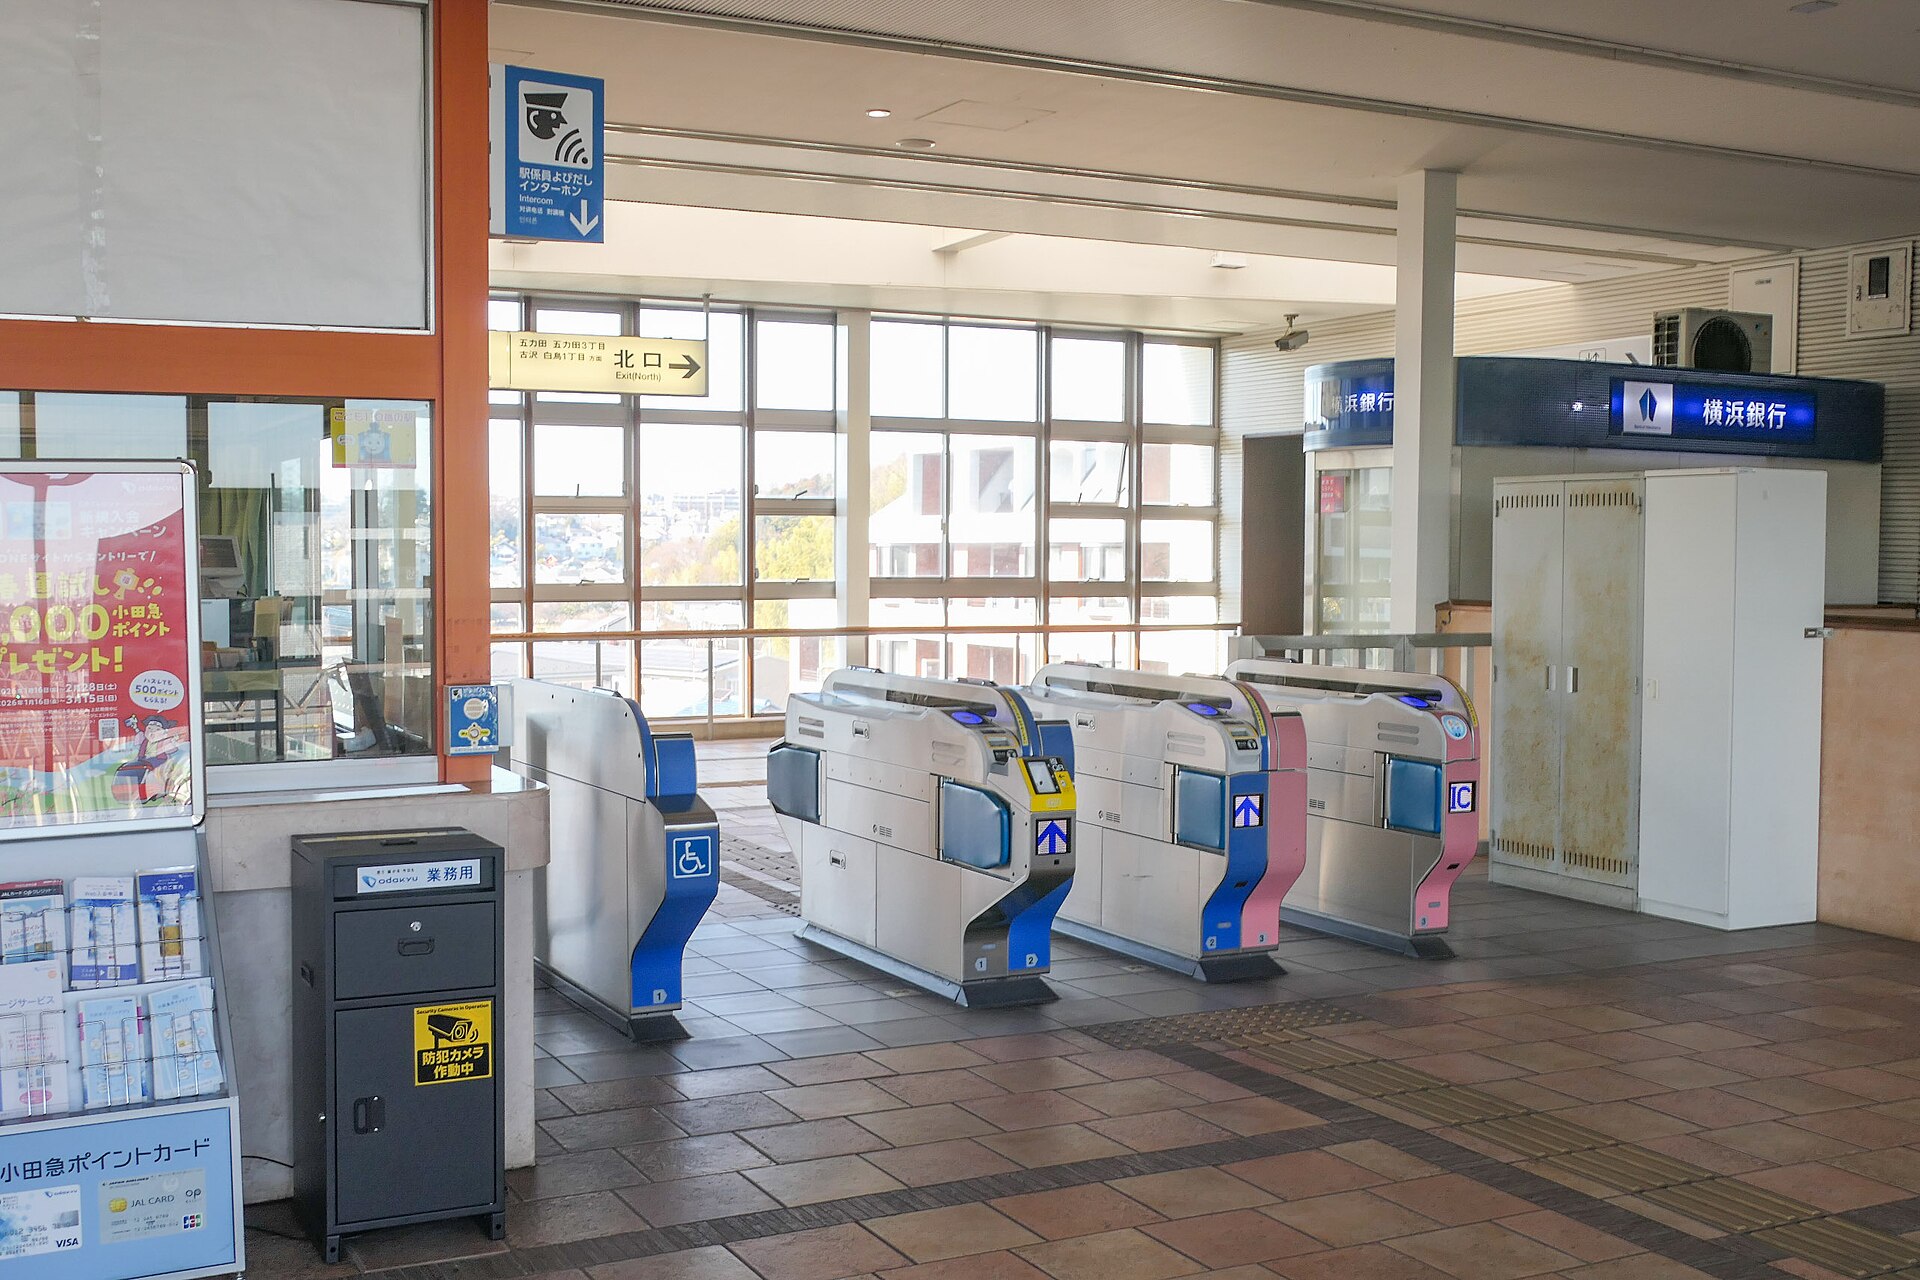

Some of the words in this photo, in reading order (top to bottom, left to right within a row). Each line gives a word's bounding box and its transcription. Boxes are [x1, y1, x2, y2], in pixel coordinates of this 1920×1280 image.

[519, 167, 593, 186] 駅係員よびだし
[520, 181, 581, 197] インターホン
[519, 194, 554, 205] Intercom
[519, 338, 547, 348] 五力田
[553, 340, 605, 351] 五力田3丁目
[519, 350, 538, 359] 古沢
[614, 349, 662, 368] 北口
[615, 371, 662, 382] Exit(North)
[1702, 398, 1787, 430] 横浜銀行
[112, 602, 163, 620] 小田急
[112, 622, 171, 638] ポイント
[1450, 786, 1471, 809] IC
[427, 865, 473, 882] 業務用
[1259, 934, 1265, 942] 3
[1028, 956, 1034, 965] 2
[657, 991, 661, 1001] 1
[465, 1003, 489, 1011] Operation
[422, 1046, 484, 1066] 防犯カメラ
[433, 1061, 474, 1080] 作動中
[0, 1137, 211, 1183] 小田急ポイントカード
[131, 1200, 145, 1208] JAL
[148, 1194, 175, 1205] CARD
[56, 1237, 79, 1248] VISA
